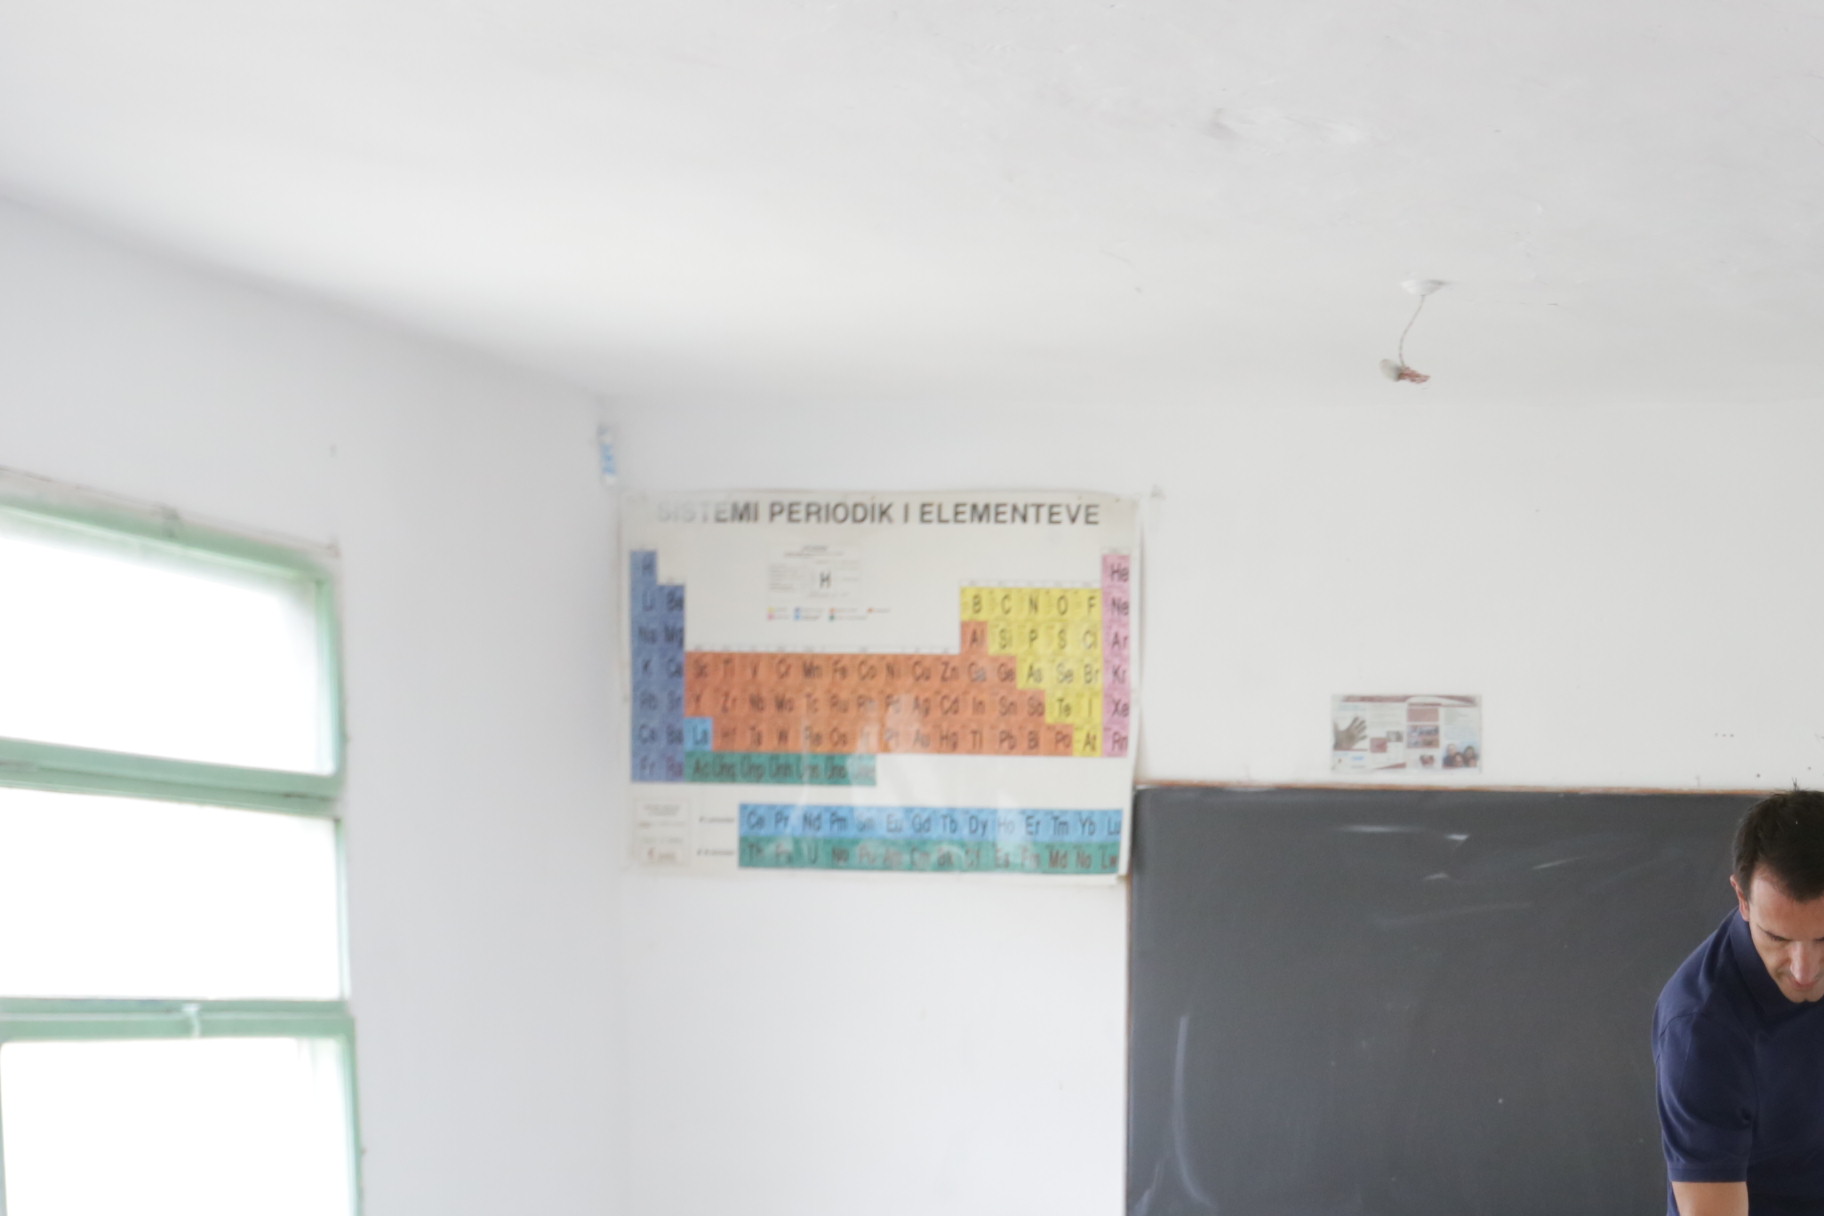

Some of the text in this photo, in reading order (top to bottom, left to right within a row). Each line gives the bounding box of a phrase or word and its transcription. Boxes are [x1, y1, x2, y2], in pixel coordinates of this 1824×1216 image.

[656, 501, 1100, 525] SISTEMI PERIODIK I ELEMENTEVE
